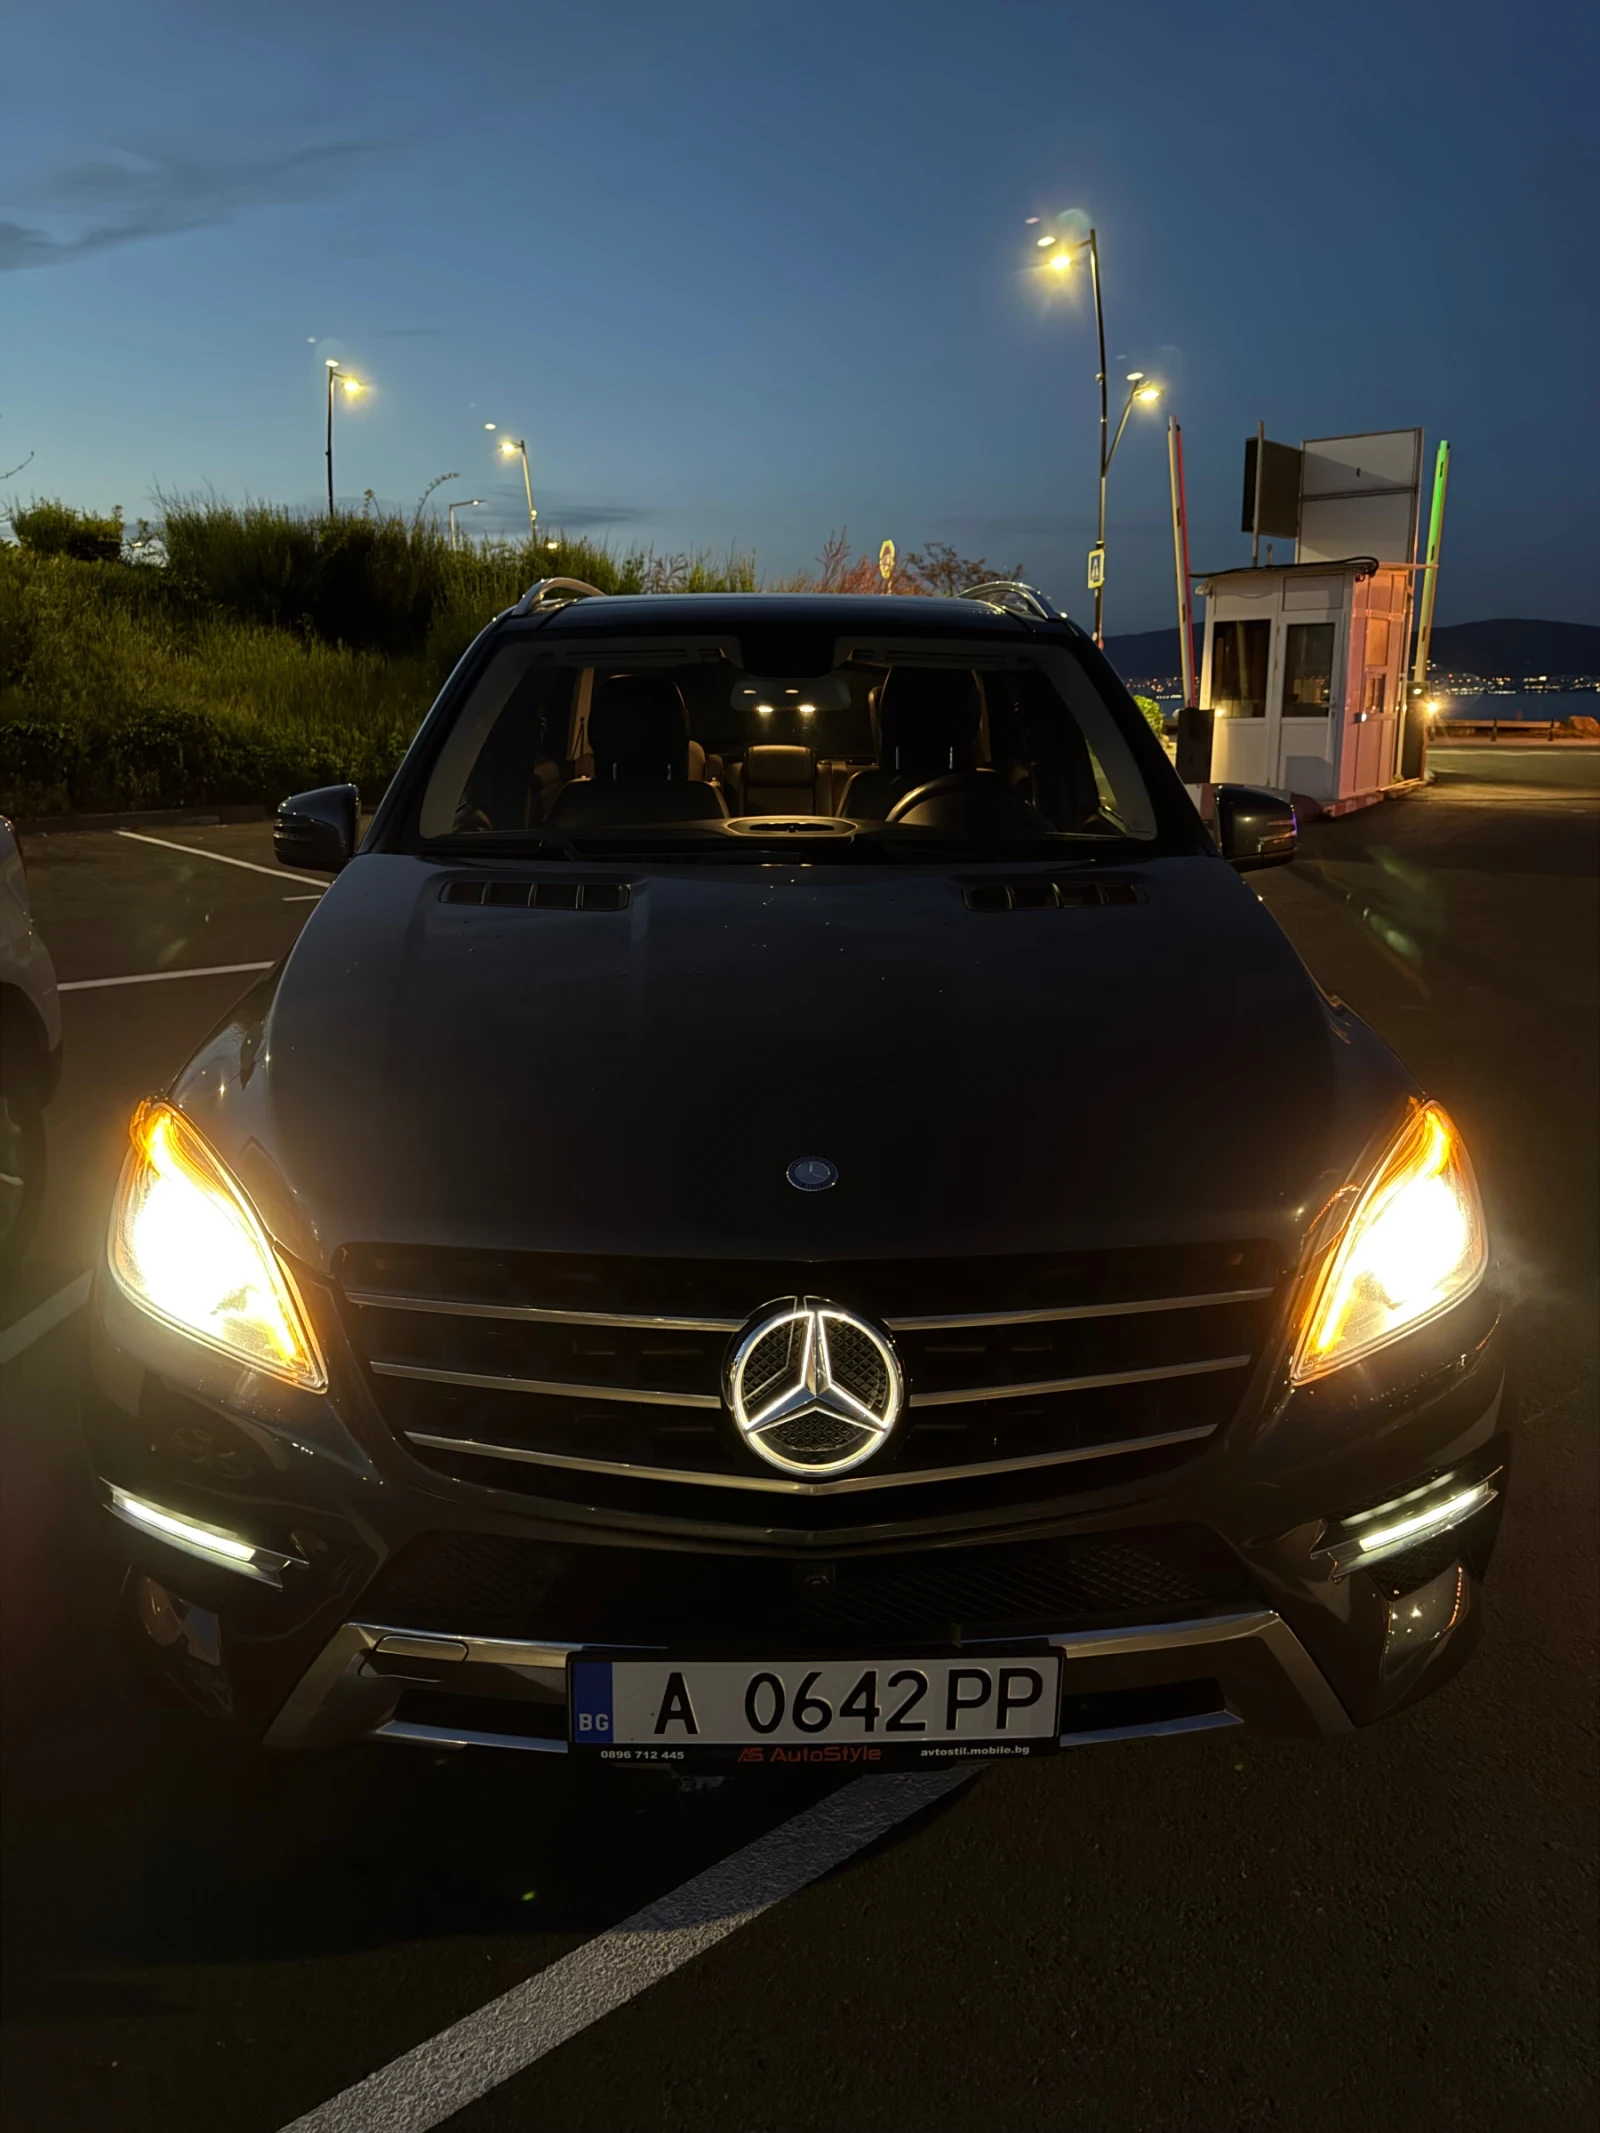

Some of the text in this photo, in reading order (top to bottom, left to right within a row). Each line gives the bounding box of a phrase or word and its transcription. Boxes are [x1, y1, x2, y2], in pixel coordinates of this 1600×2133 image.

[654, 1666, 1043, 1735] A 0642 PP
[579, 1713, 609, 1732] BG
[600, 1749, 685, 1760] 0896 712 445
[769, 1745, 882, 1764] AutoStyle
[920, 1744, 1031, 1757] avtostil.mobile.bg
